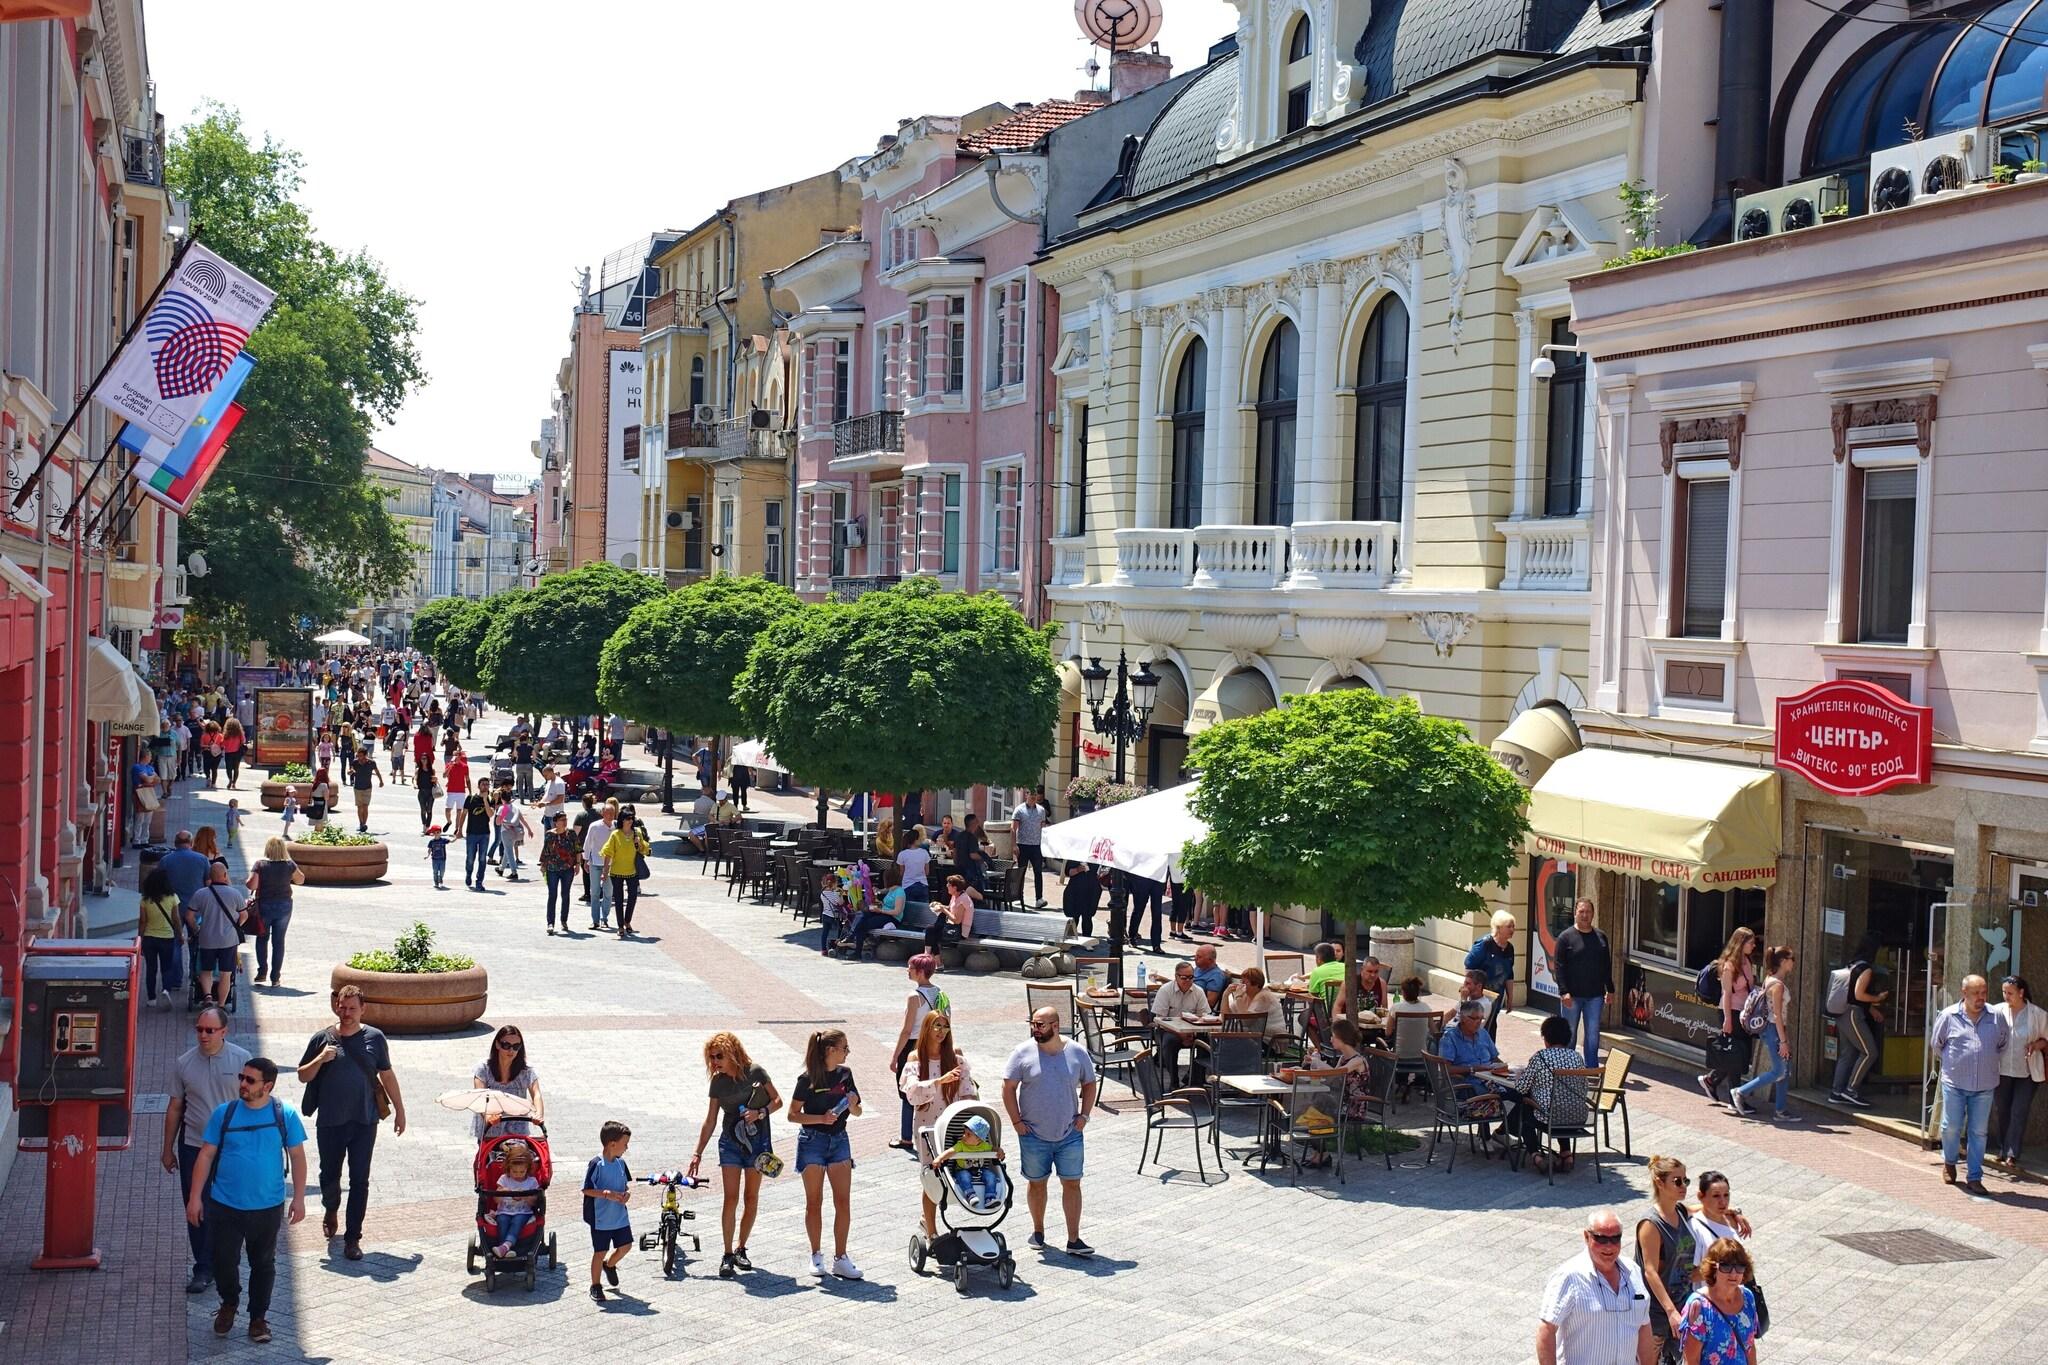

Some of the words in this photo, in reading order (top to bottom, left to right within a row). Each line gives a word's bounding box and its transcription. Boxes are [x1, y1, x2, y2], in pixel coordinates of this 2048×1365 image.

[180, 276, 205, 296] PLOVDIV
[203, 292, 219, 305] 2019
[230, 289, 260, 311] #together
[232, 281, 245, 293] let's
[245, 290, 265, 306] create
[626, 311, 642, 321] 5/6
[122, 382, 153, 405] European
[126, 393, 149, 411] Capital
[113, 394, 122, 402] of
[120, 398, 145, 417] Culture
[112, 723, 145, 732] CHANGE
[1790, 700, 1853, 722] ХРАНИТЕЛЕН
[1853, 702, 1908, 732] КОМПЛЕКС
[1811, 725, 1883, 750] ЦЕНТЪР
[1871, 755, 1904, 776] ЕООД
[1536, 836, 1566, 855] СУПИ
[1579, 845, 1642, 871] САНДВИЧИ
[1651, 859, 1690, 881] СКАРА
[1702, 867, 1775, 883] САНДВИЧИ
